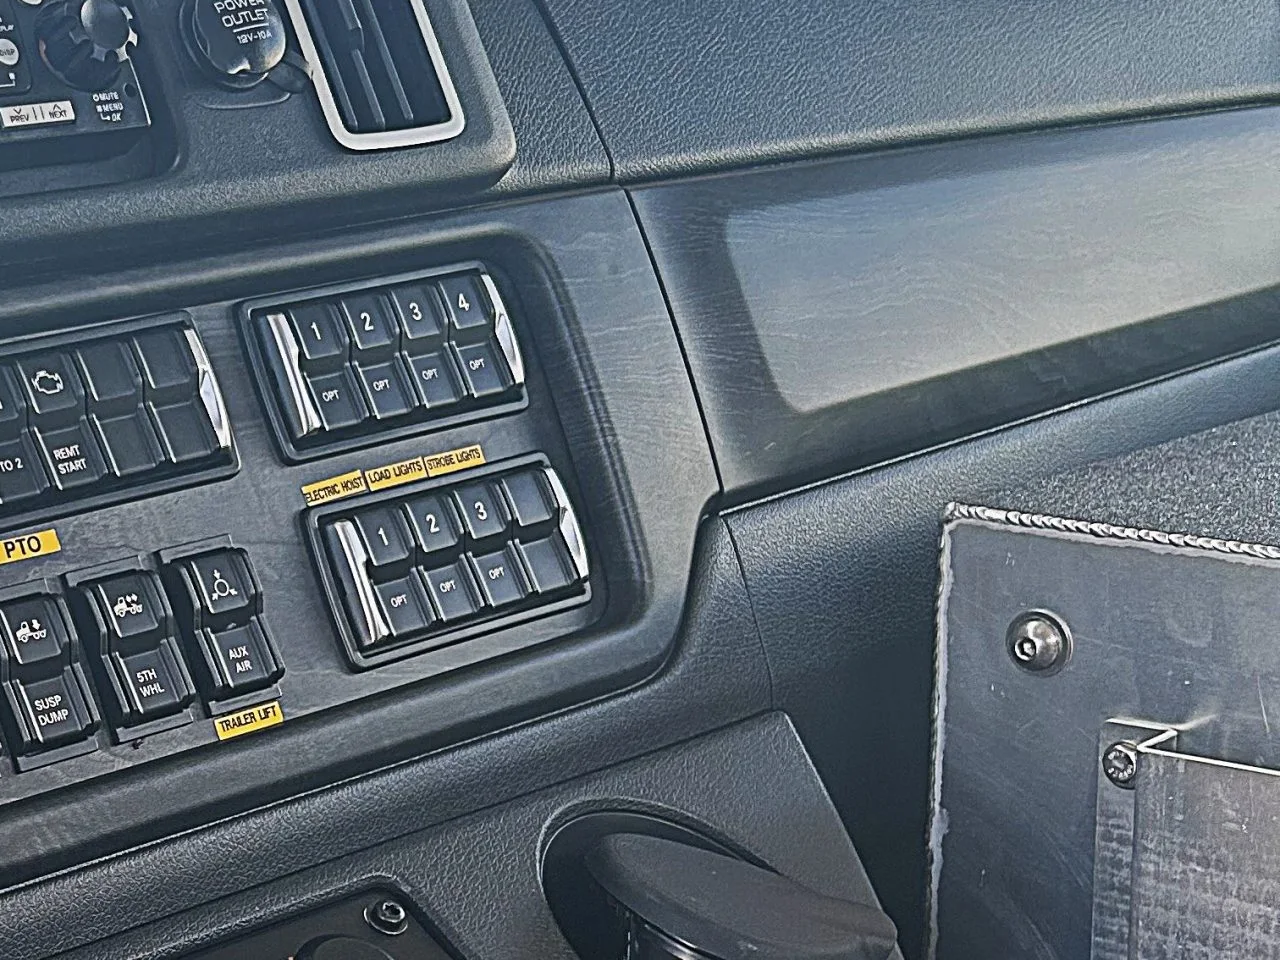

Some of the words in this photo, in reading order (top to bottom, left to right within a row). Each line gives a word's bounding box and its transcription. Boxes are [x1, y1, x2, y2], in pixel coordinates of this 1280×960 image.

[222, 8, 269, 28] OUTLET
[236, 31, 273, 45] 12V-10A
[10, 112, 30, 124] PREV
[48, 108, 68, 120] NEXT
[458, 293, 470, 312] 4
[409, 302, 422, 321] 3
[360, 312, 374, 332] 2
[310, 322, 321, 340] 1
[469, 358, 485, 372] OPT
[422, 368, 439, 381] OPT
[373, 378, 390, 392] OPT
[322, 390, 340, 403] OPT
[53, 444, 80, 460] REMT
[426, 454, 456, 471] STROBE
[456, 448, 481, 464] LIGHTS
[14, 458, 24, 470] 2
[58, 458, 88, 474] START
[368, 469, 391, 484] LOAD
[394, 460, 422, 478] LIGHTS
[304, 483, 340, 503] ELECTRIC
[342, 476, 365, 492] HOIST
[474, 501, 488, 520] 3
[426, 514, 440, 534] 2
[378, 527, 389, 546] 1
[3, 535, 42, 559] PTO
[488, 566, 505, 580] OPT
[440, 580, 456, 593] OPT
[390, 594, 408, 608] OPT
[228, 646, 249, 660] AUX
[235, 660, 253, 674] AIR
[136, 668, 157, 683] 5TH
[139, 681, 166, 698] WHL
[34, 694, 62, 712] SUSP
[38, 708, 69, 727] DUMP
[219, 710, 256, 733] TRAILER
[258, 706, 277, 720] LIFT
